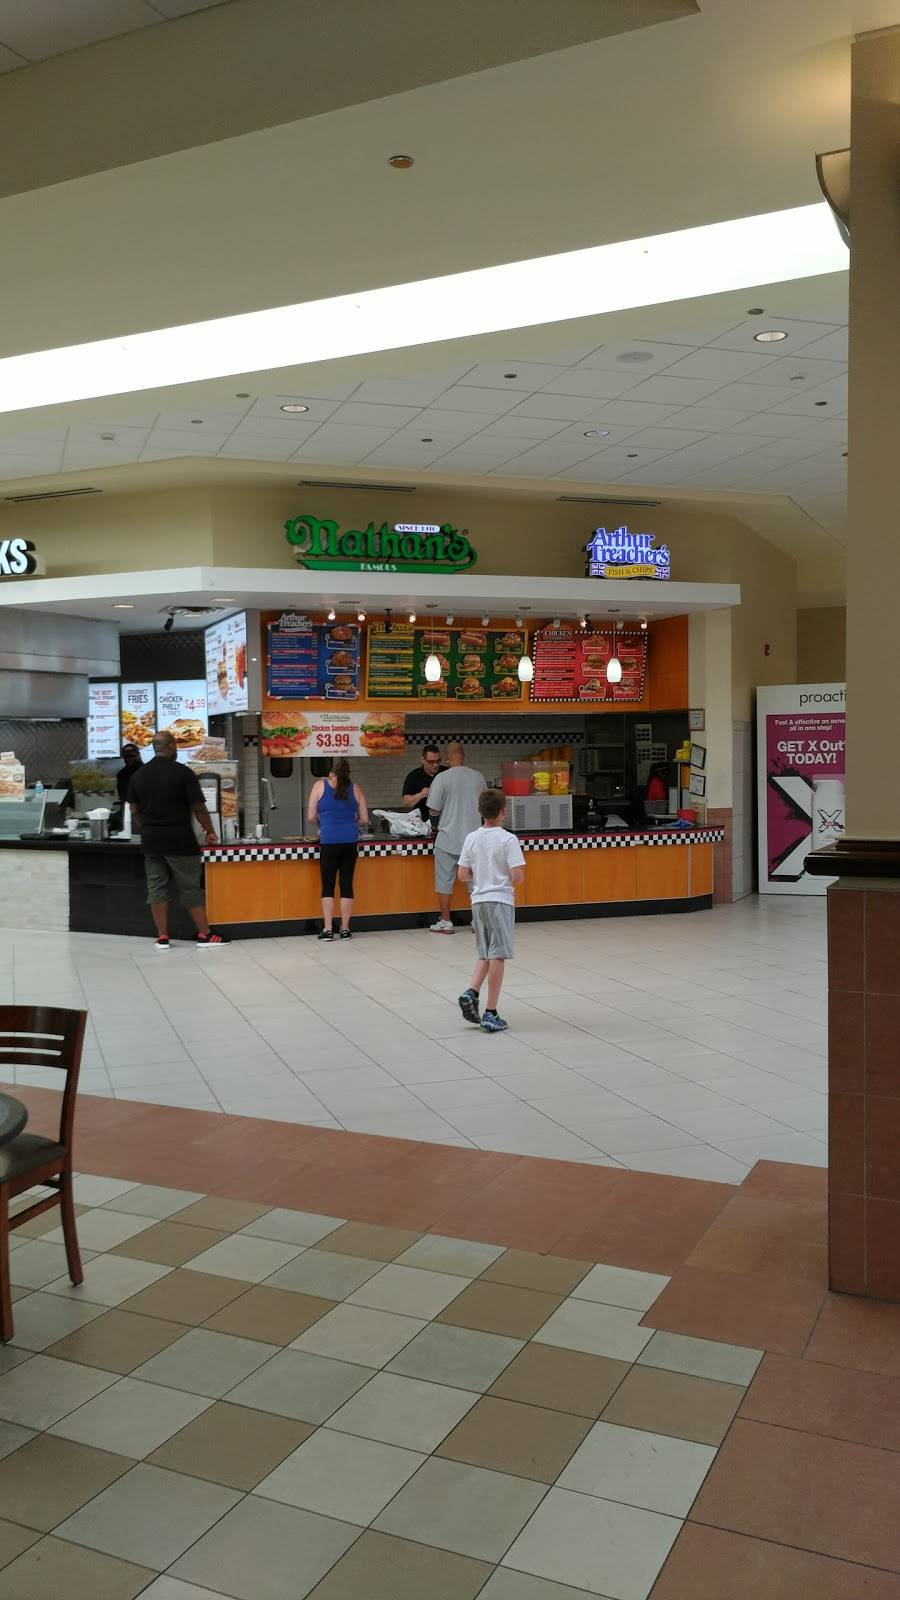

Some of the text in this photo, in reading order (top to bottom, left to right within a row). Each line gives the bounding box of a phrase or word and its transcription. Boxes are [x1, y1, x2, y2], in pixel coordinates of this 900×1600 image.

[284, 514, 476, 562] Nathan's
[588, 526, 656, 548] Arthur
[588, 544, 670, 566] Treacher's
[360, 563, 397, 571] FAMOUS
[608, 568, 625, 576] FISH
[279, 612, 307, 621] Arthur
[128, 695, 149, 704] FRIES
[160, 695, 183, 703] CHICKEN
[185, 698, 206, 711] $4.99
[162, 703, 180, 711] PHILLY
[316, 733, 350, 747] $3.99
[777, 739, 844, 752] GET X Out
[786, 753, 837, 765] TODAY!
